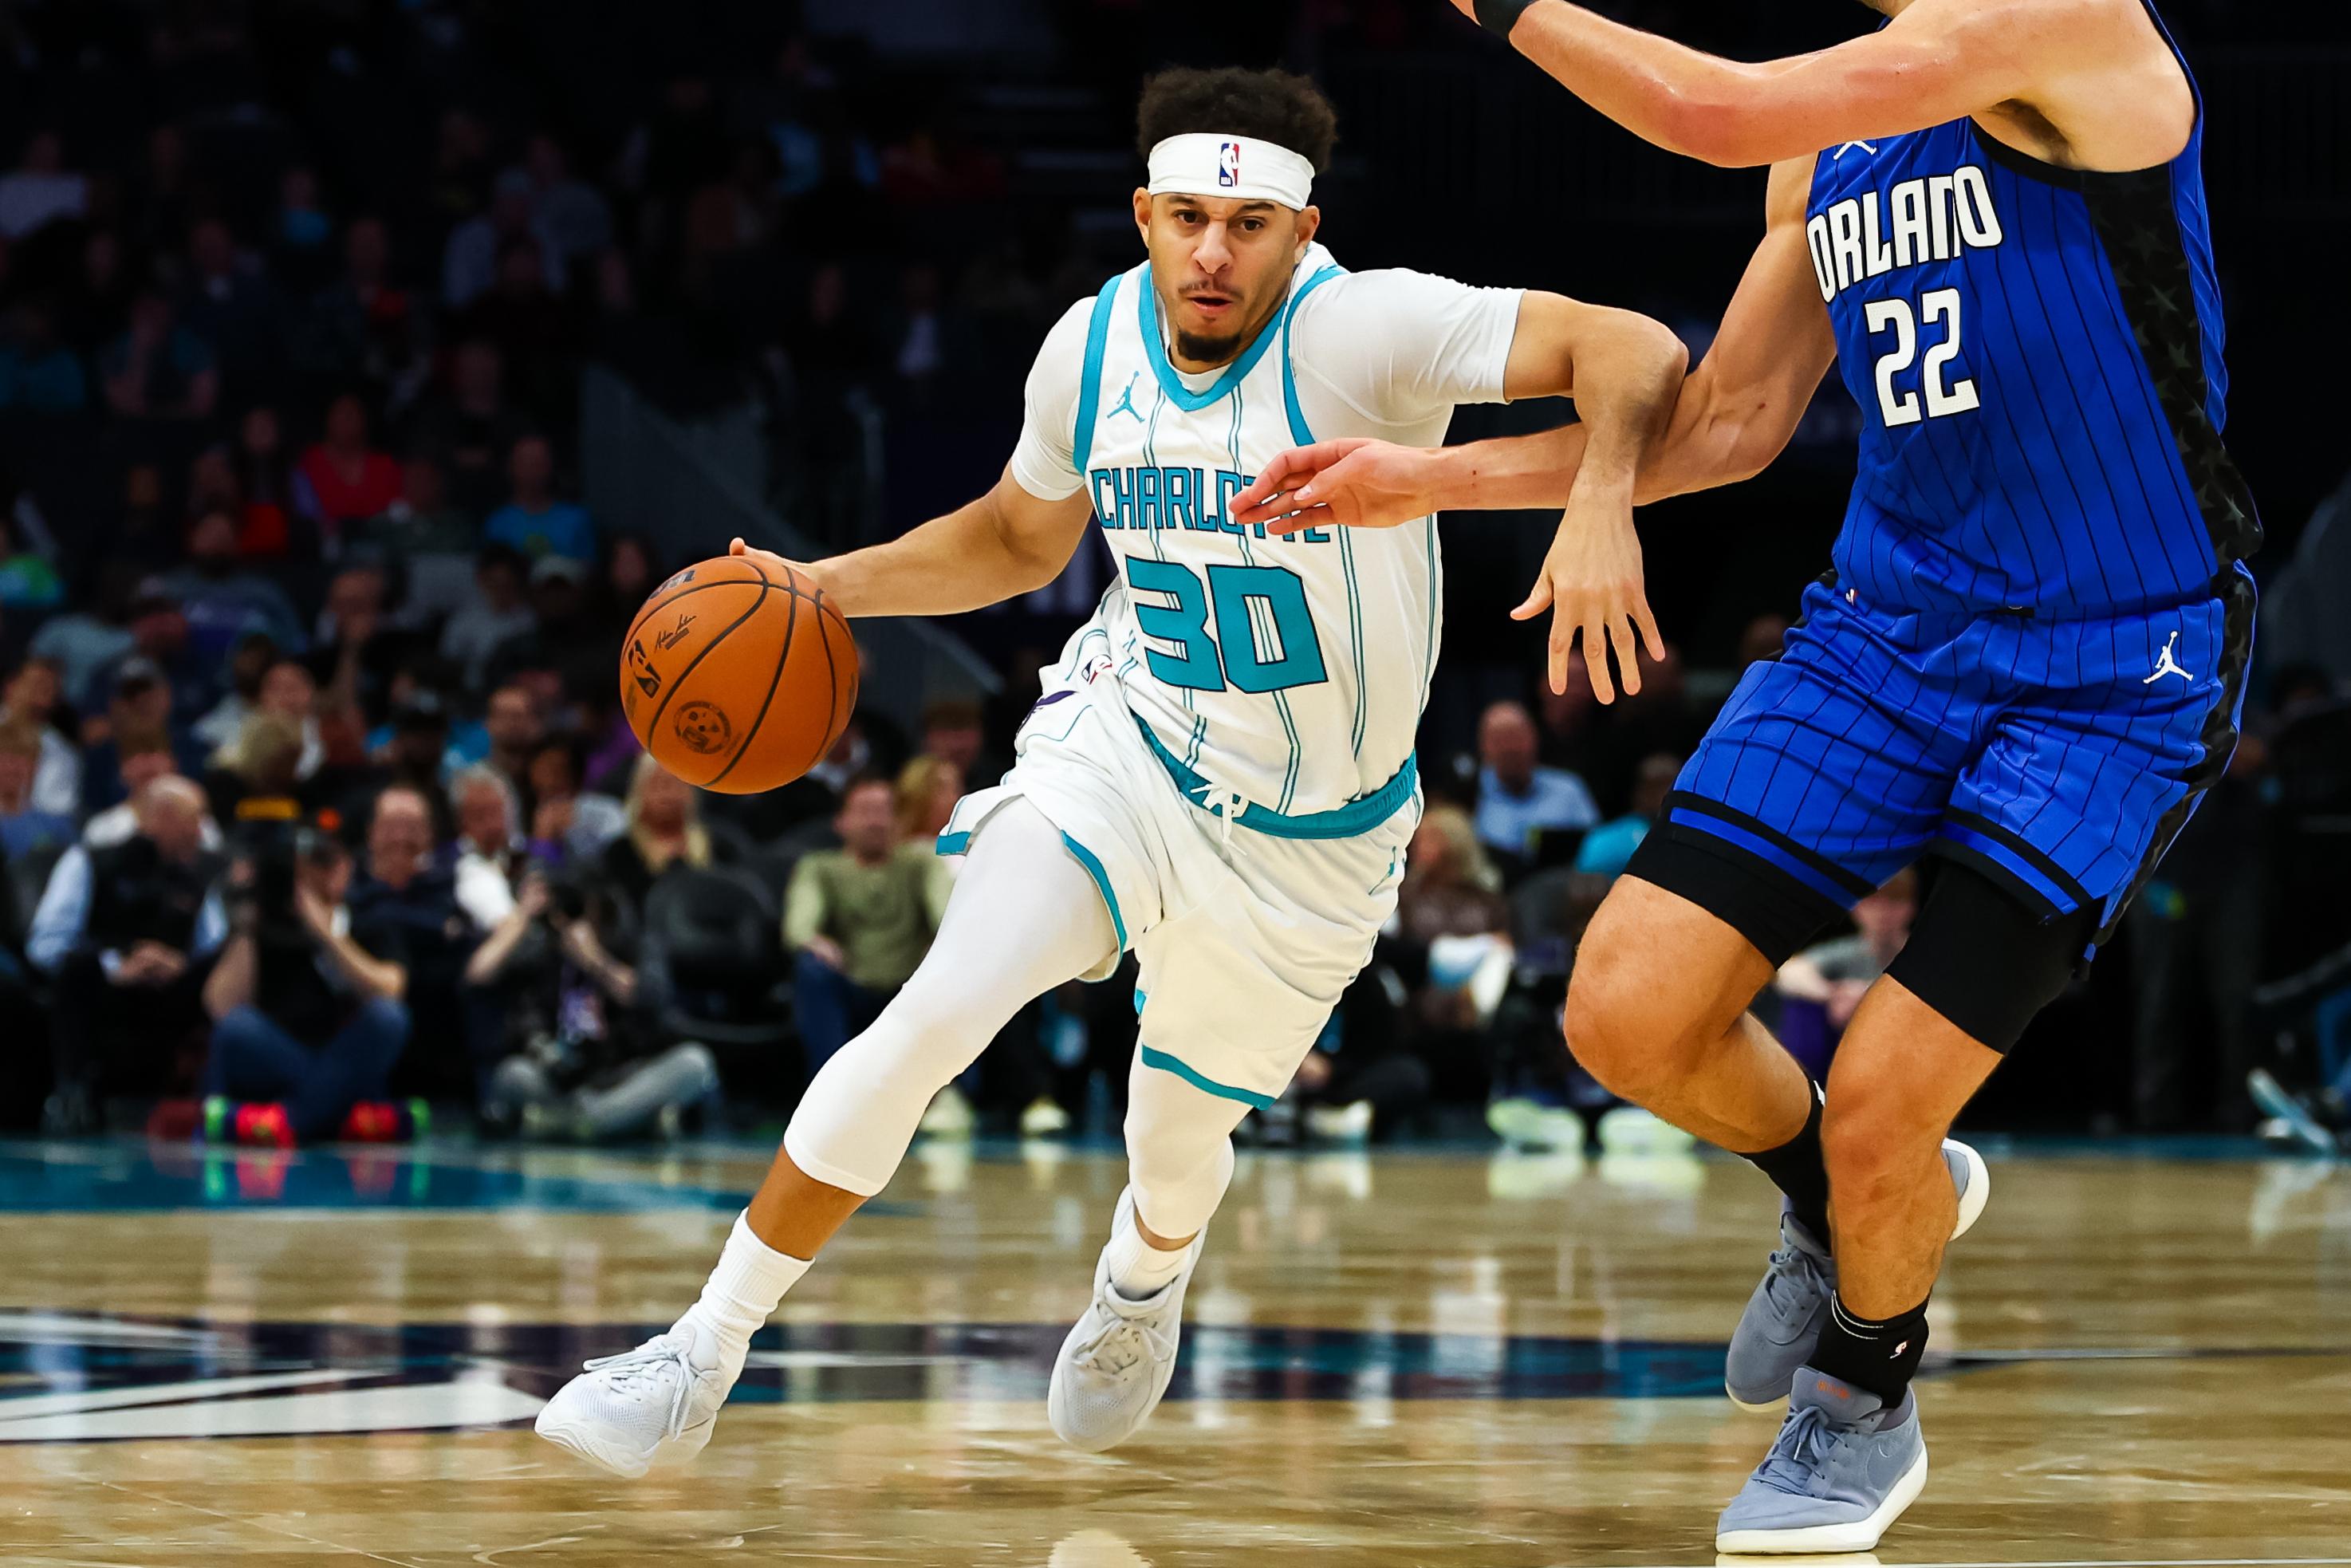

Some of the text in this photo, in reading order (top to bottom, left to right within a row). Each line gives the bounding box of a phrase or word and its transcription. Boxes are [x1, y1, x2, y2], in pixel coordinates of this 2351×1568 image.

[1806, 164, 2002, 303] ORLANO
[1864, 287, 1980, 427] 22
[1089, 467, 1331, 543] CHARLO
[1124, 554, 1329, 694] 30
